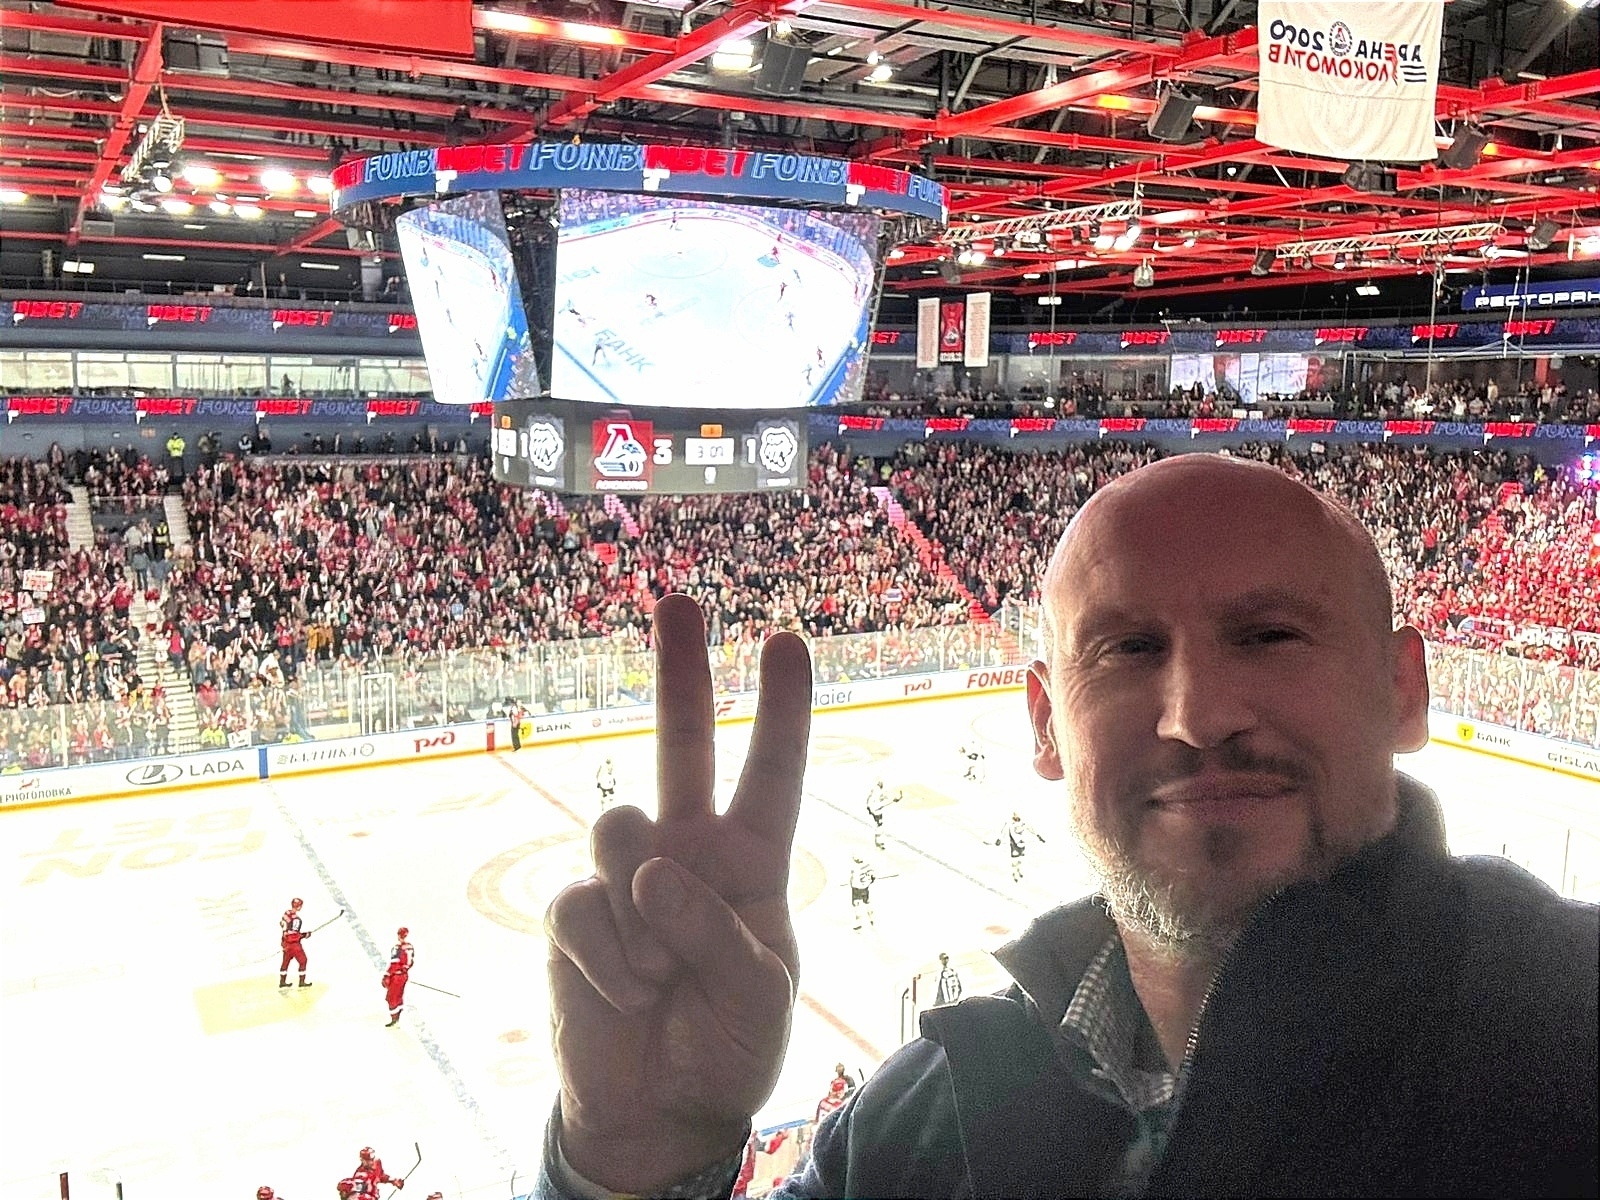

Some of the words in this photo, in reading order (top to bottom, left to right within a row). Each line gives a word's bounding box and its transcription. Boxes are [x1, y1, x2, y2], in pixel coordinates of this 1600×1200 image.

[652, 438, 673, 465] 3
[746, 438, 757, 464] 1
[967, 668, 1026, 689] FONBE
[535, 721, 572, 734] БАНК
[189, 759, 245, 777] LADA
[0, 787, 72, 803] РНОГОЛОВКА
